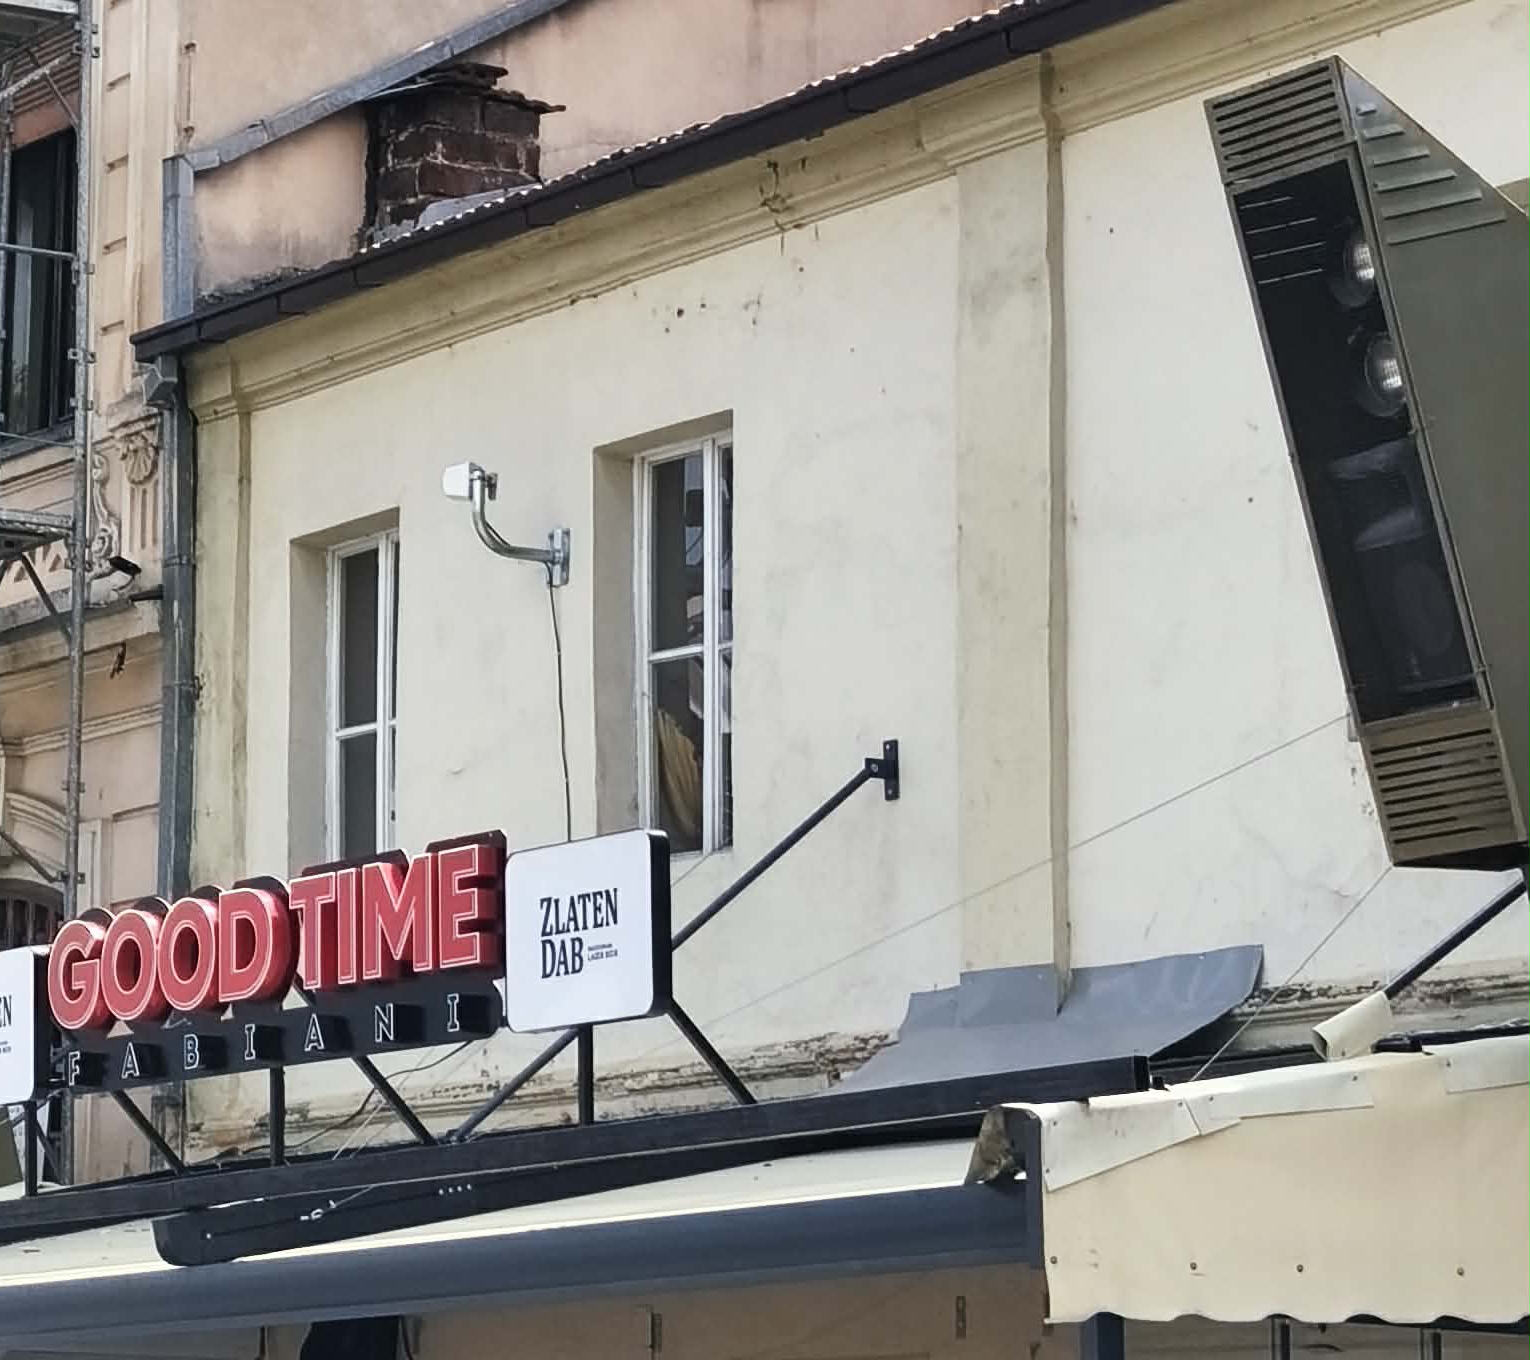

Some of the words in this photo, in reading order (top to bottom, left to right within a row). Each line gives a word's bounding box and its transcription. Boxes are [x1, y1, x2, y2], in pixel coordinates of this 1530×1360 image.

[47, 885, 276, 1032] GOOD
[288, 843, 482, 992] TIME
[539, 887, 618, 938] ZLATEN
[540, 936, 584, 979] DAB
[68, 993, 461, 1087] FABIANI
